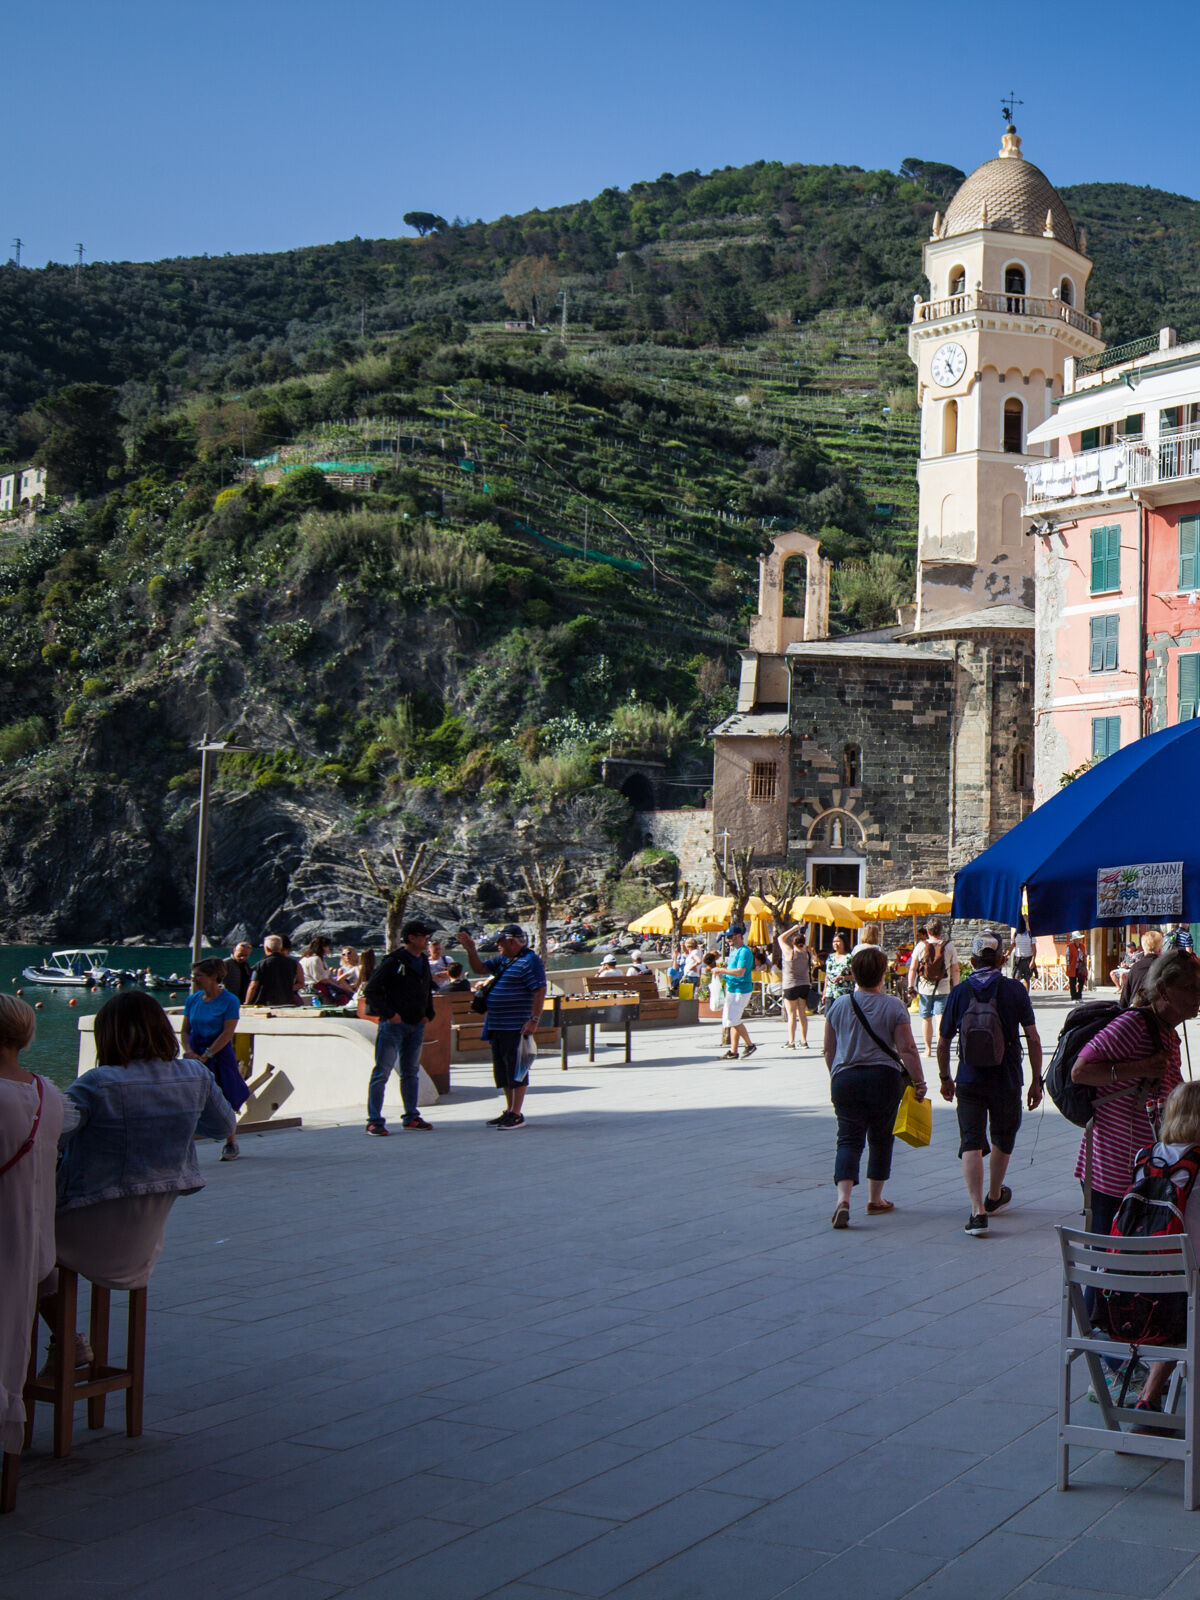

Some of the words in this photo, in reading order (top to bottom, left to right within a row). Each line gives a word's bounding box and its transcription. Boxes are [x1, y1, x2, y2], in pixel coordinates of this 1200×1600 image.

[1142, 864, 1180, 876] GIANNI
[1142, 888, 1178, 896] VERNAZZA
[1141, 899, 1149, 913] 5
[1152, 903, 1179, 913] TERRE
